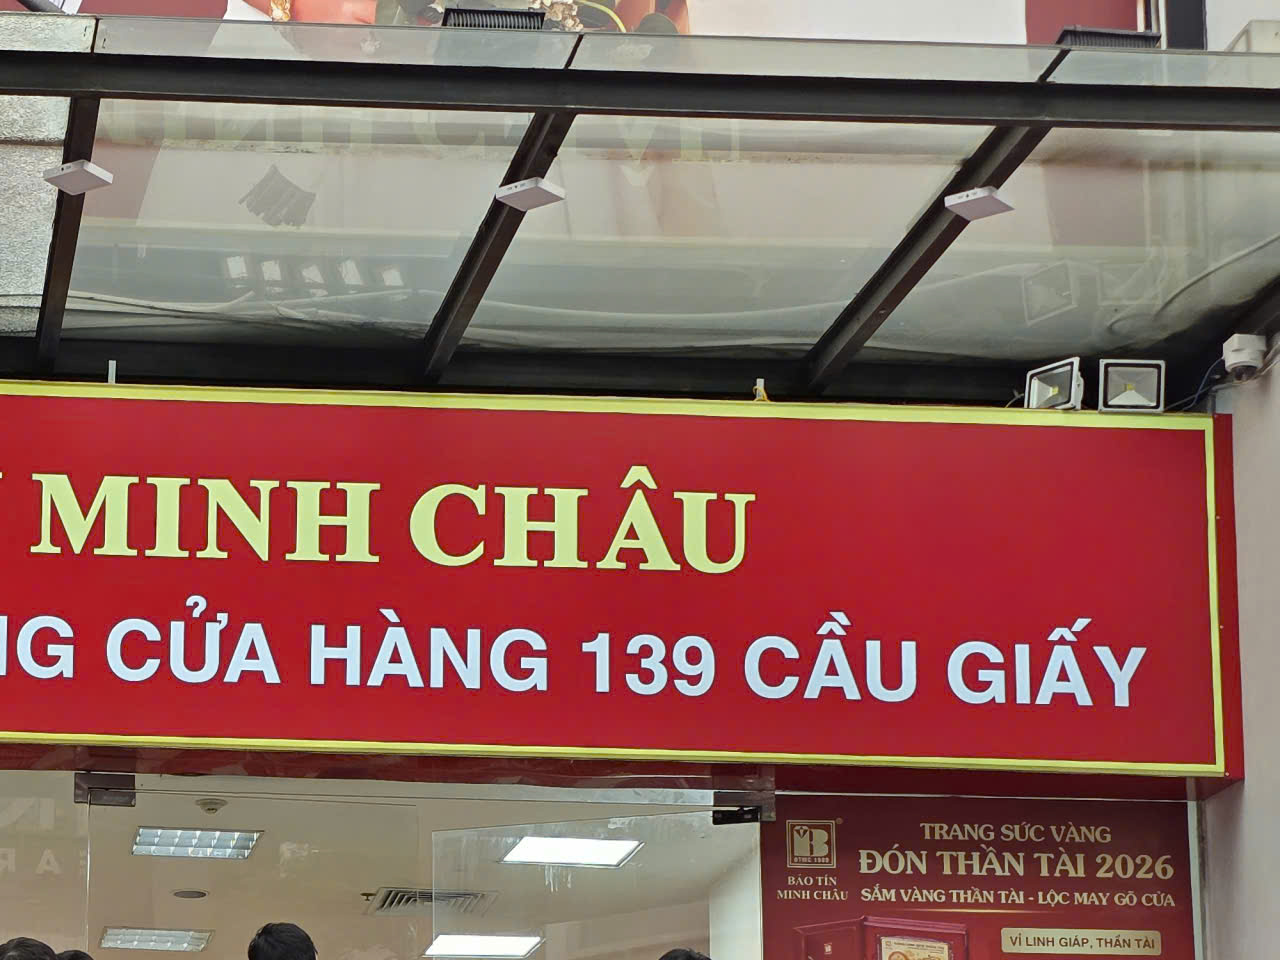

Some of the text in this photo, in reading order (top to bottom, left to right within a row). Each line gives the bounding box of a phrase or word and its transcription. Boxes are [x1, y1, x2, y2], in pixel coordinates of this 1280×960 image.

[30, 473, 381, 563] MINH
[408, 465, 756, 574] CHÂU
[105, 594, 280, 684] CỬA
[309, 608, 549, 692] HÀNG
[582, 632, 716, 697] 139
[744, 611, 917, 702] CẦU
[946, 618, 1147, 708] GIẤY
[920, 821, 1112, 843] TRANG SỨC VÀNG
[858, 843, 1175, 880] ĐÓN THẦN TÀI 2026
[787, 873, 837, 886] BẢO TÍN
[777, 888, 849, 901] MINH CHÂU
[860, 884, 896, 902] SẮM
[900, 887, 946, 903] VÀNG
[949, 887, 995, 903] THẦN
[997, 888, 1025, 904] TÀI
[1038, 888, 1070, 907] LỘC
[1074, 892, 1110, 906] MAY
[1025, 936, 1055, 947] LINH
[1096, 934, 1131, 948] THẦN
[1134, 936, 1155, 949] TÀI
